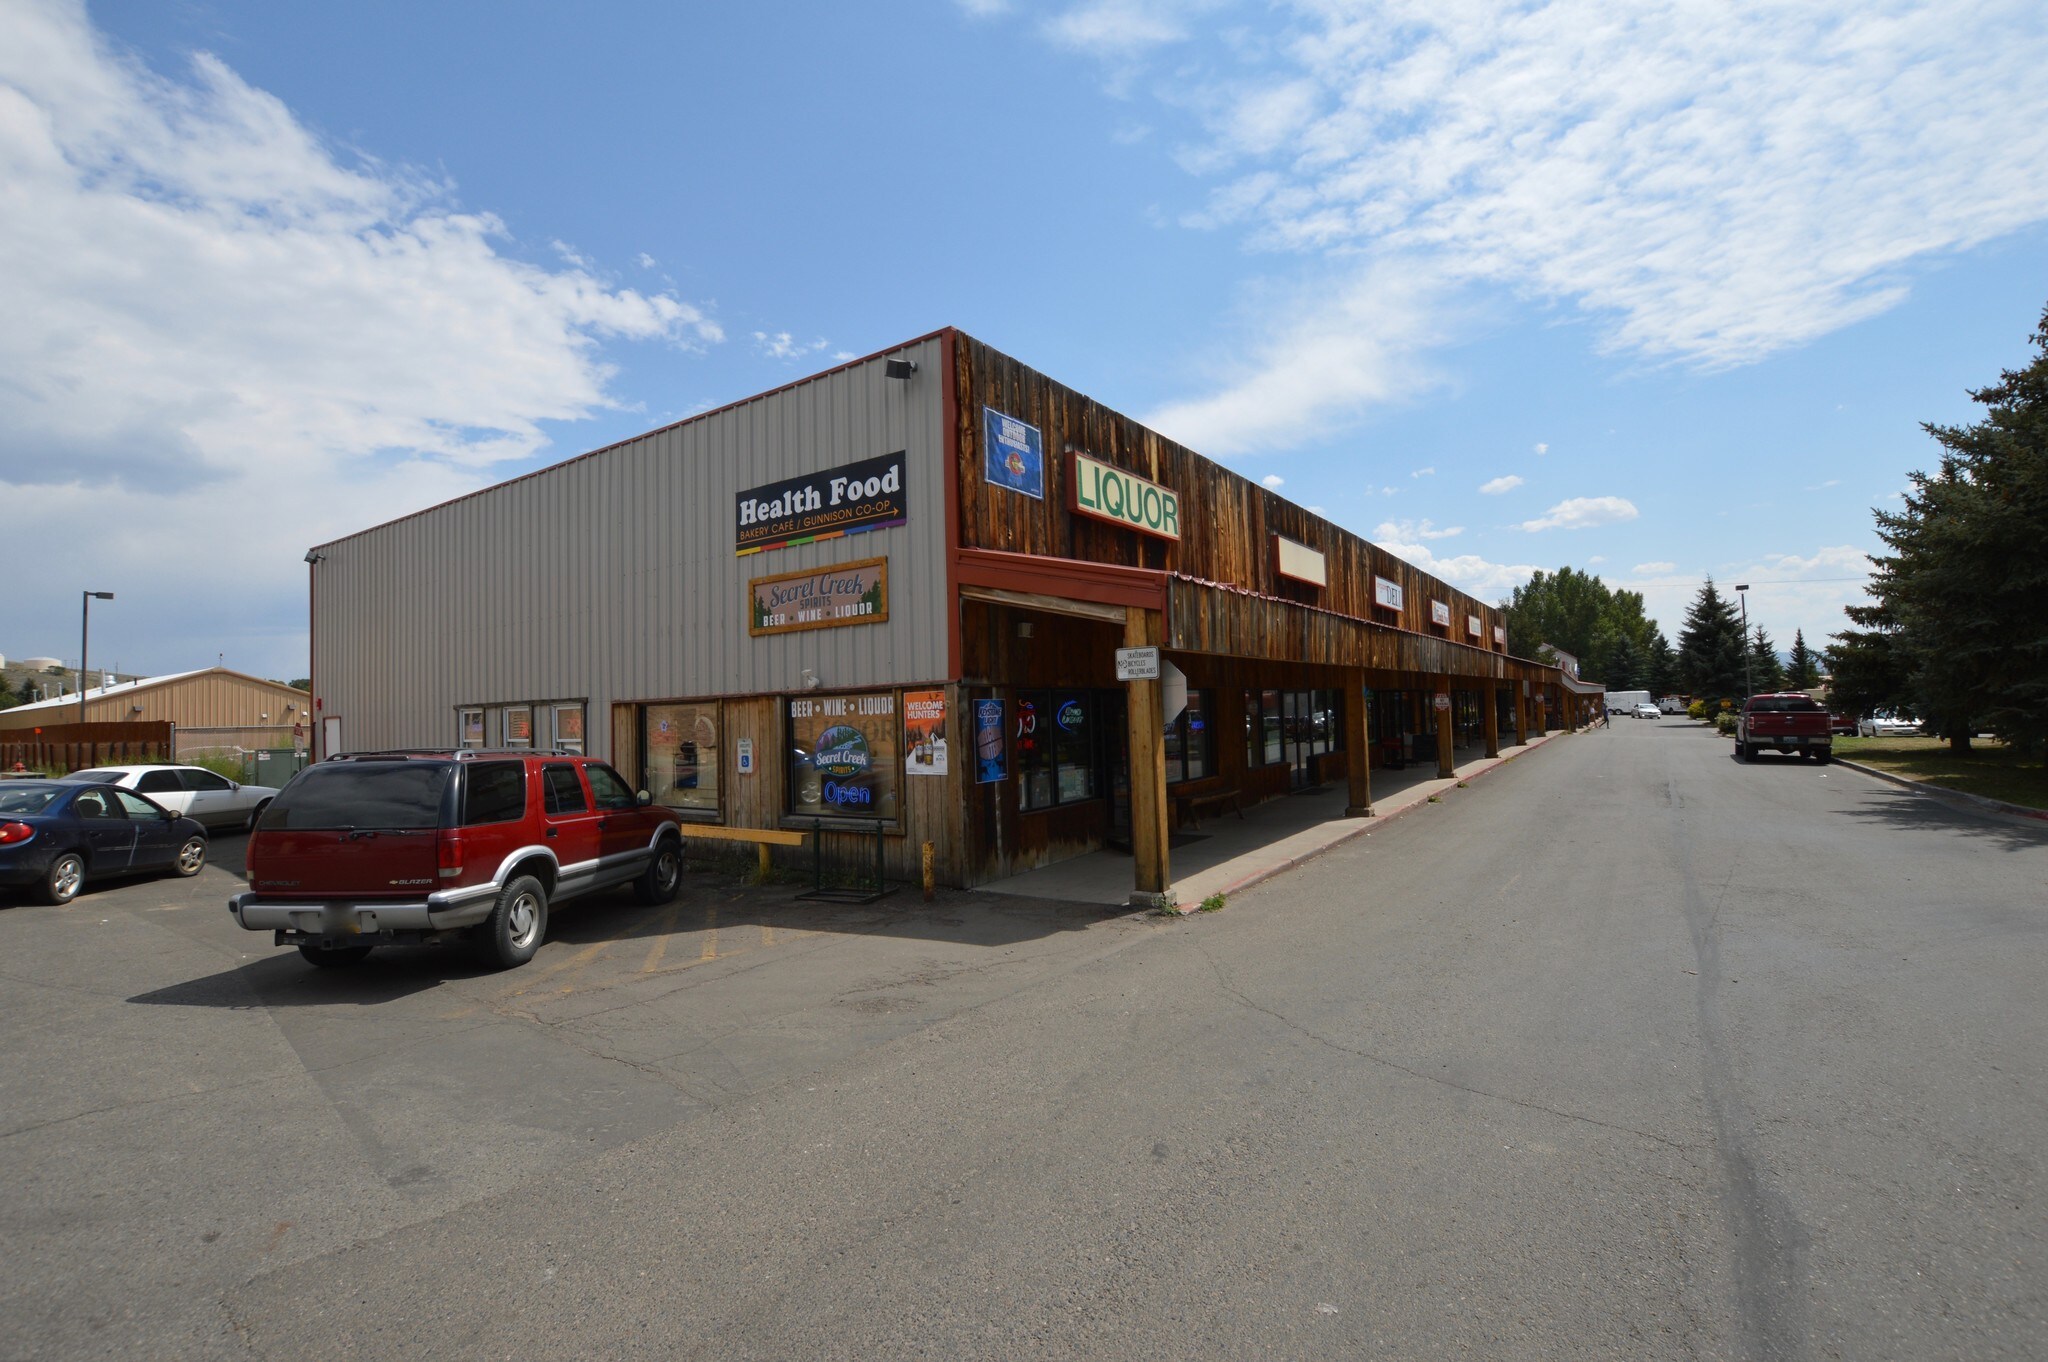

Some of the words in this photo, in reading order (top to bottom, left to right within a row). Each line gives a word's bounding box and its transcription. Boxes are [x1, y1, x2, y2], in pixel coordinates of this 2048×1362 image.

[739, 486, 821, 525] Health
[830, 465, 899, 505] Food
[1077, 460, 1178, 535] LIQUOR
[740, 527, 769, 540] BAKERY
[771, 519, 794, 533] CAFÉ
[803, 508, 852, 527] GUNNISON
[855, 500, 891, 516] CO-OP
[770, 578, 815, 608] Secret
[819, 574, 864, 596] Creek
[800, 596, 832, 609] SPIRITS
[1386, 585, 1401, 608] DELI
[763, 614, 785, 627] BEER
[798, 609, 822, 622] WINE
[835, 602, 873, 618] LIQUOR
[791, 701, 813, 718] BEER
[823, 699, 847, 716] WINE
[858, 696, 894, 715] LIQUOR
[907, 700, 943, 711] WELCOME
[907, 709, 940, 720] HUNTERS
[816, 752, 842, 766] Secret
[842, 750, 867, 766] Creek
[824, 780, 870, 804] Open
[398, 877, 433, 885] BLAZER
